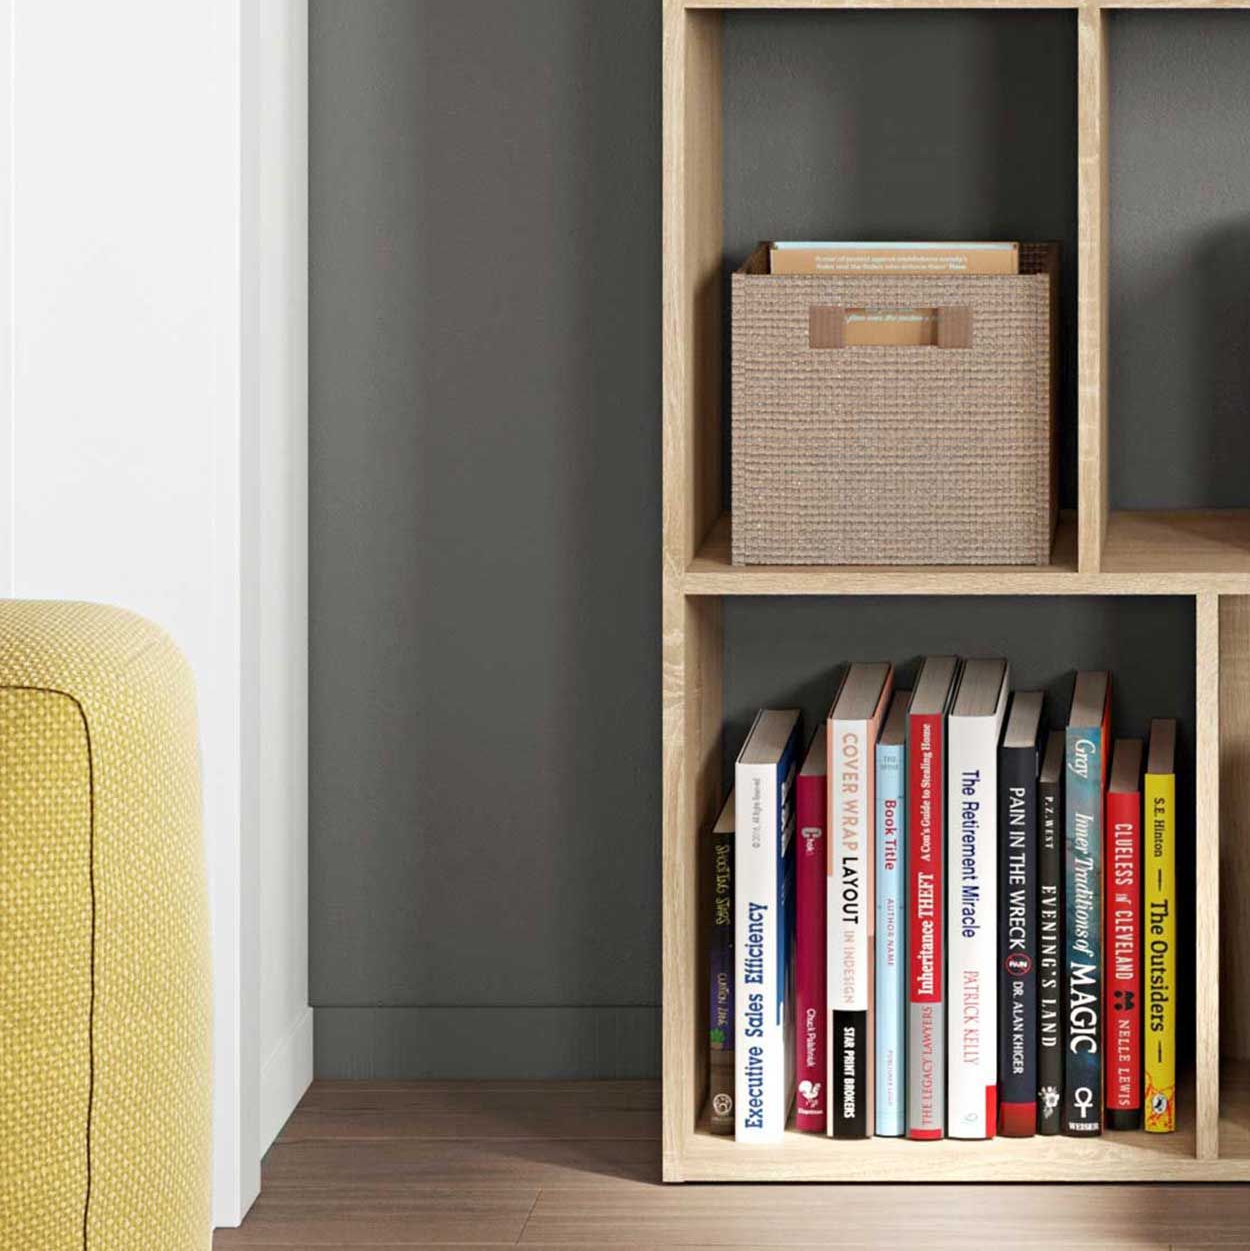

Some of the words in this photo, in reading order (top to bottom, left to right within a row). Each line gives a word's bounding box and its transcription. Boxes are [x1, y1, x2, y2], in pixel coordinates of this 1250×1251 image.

[920, 724, 931, 751] Home
[841, 732, 858, 793] COVER
[920, 752, 932, 788] Stealing
[1068, 739, 1097, 778] Gray
[920, 789, 931, 799] to
[961, 769, 981, 797] The
[841, 798, 858, 850] WRAP
[884, 799, 898, 826] Book
[920, 800, 931, 827] Guide
[1009, 788, 1025, 826] PAIN
[1154, 797, 1166, 816] S.E.
[884, 829, 898, 870] Title
[920, 829, 931, 853] Con's
[961, 801, 981, 880] Retirement
[1009, 830, 1025, 847] IN
[1074, 812, 1094, 854] Inner
[1154, 819, 1166, 857] Hinton
[920, 854, 931, 862] A
[1009, 852, 1025, 884] THE
[1115, 823, 1133, 885] CLUELESS
[842, 856, 858, 924] LAYOUT
[918, 872, 935, 919] THEFT
[1074, 857, 1094, 932] Traditions
[886, 898, 895, 937] AUTHOR
[961, 884, 981, 938] Miracle
[1009, 891, 1025, 950] WRECK
[1150, 899, 1168, 934] The
[744, 902, 769, 984] Efficiency
[843, 930, 855, 942] IN
[886, 940, 895, 966] NAME
[1041, 885, 1057, 988] EVENING'S
[1071, 933, 1094, 958] of
[1115, 910, 1133, 980] CLEVELAND
[843, 946, 855, 1003] INDESIGN
[917, 920, 934, 996] Inheritance
[963, 970, 980, 1023] PATRICK
[1013, 981, 1024, 998] DR.
[1150, 939, 1168, 1031] Outsiders
[744, 993, 764, 1037] Sales
[806, 1008, 817, 1031] Chuck
[1013, 1001, 1024, 1031] ALAN
[1041, 999, 1057, 1048] LAND
[1069, 962, 1098, 1055] MAGIC
[842, 1026, 855, 1046] STAR
[922, 1006, 933, 1056] LAWYERS
[963, 1028, 980, 1065] KELLY
[1117, 1019, 1132, 1061] NELLE
[842, 1049, 855, 1075] PRINT
[1013, 1034, 1024, 1073] KHIGER
[744, 1046, 764, 1129] Executive
[842, 1077, 855, 1118] BROKERS
[922, 1059, 933, 1100] LEGACY
[1117, 1067, 1132, 1106] LEWIS
[922, 1104, 933, 1126] THE
